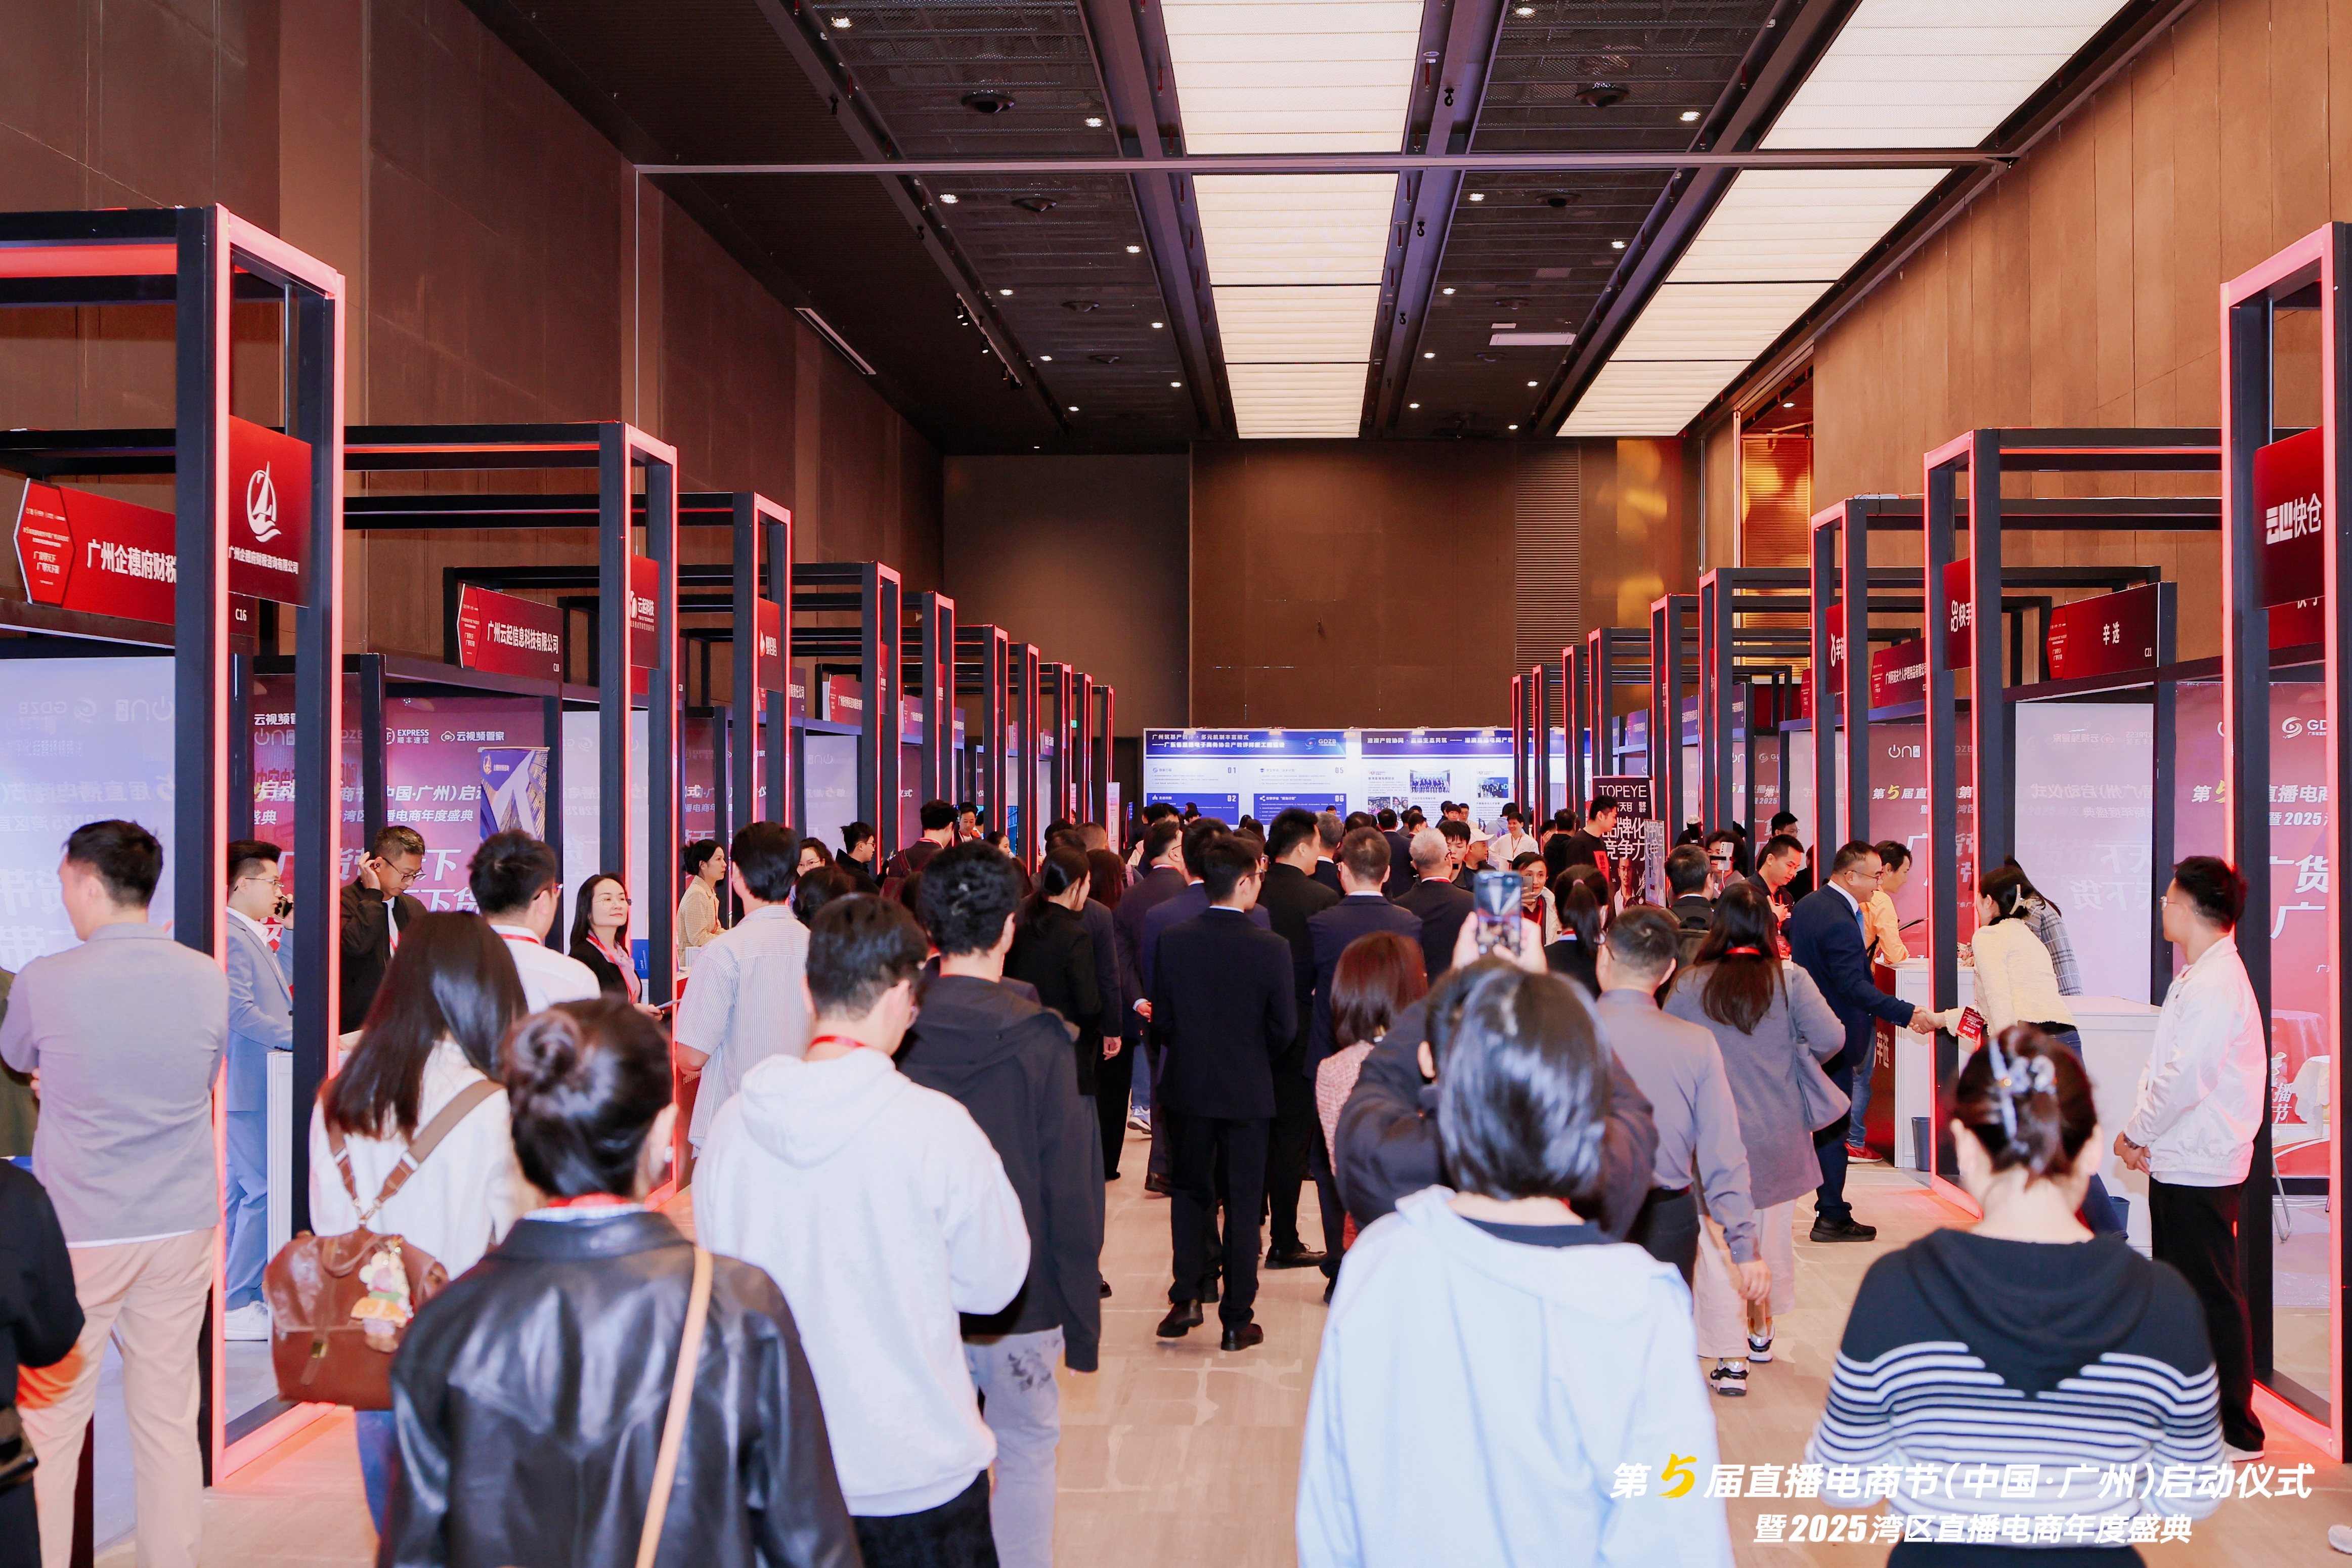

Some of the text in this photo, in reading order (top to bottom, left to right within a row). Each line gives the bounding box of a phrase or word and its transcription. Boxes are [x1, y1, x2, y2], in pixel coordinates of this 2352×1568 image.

[235, 608, 247, 622] C16
[487, 620, 559, 654] 广州云起信息科技有限公司
[2103, 621, 2120, 645] 辛选
[397, 729, 429, 737] EXPRESS
[456, 731, 505, 742] 云视频管家
[1598, 785, 1647, 798] TOPEYE
